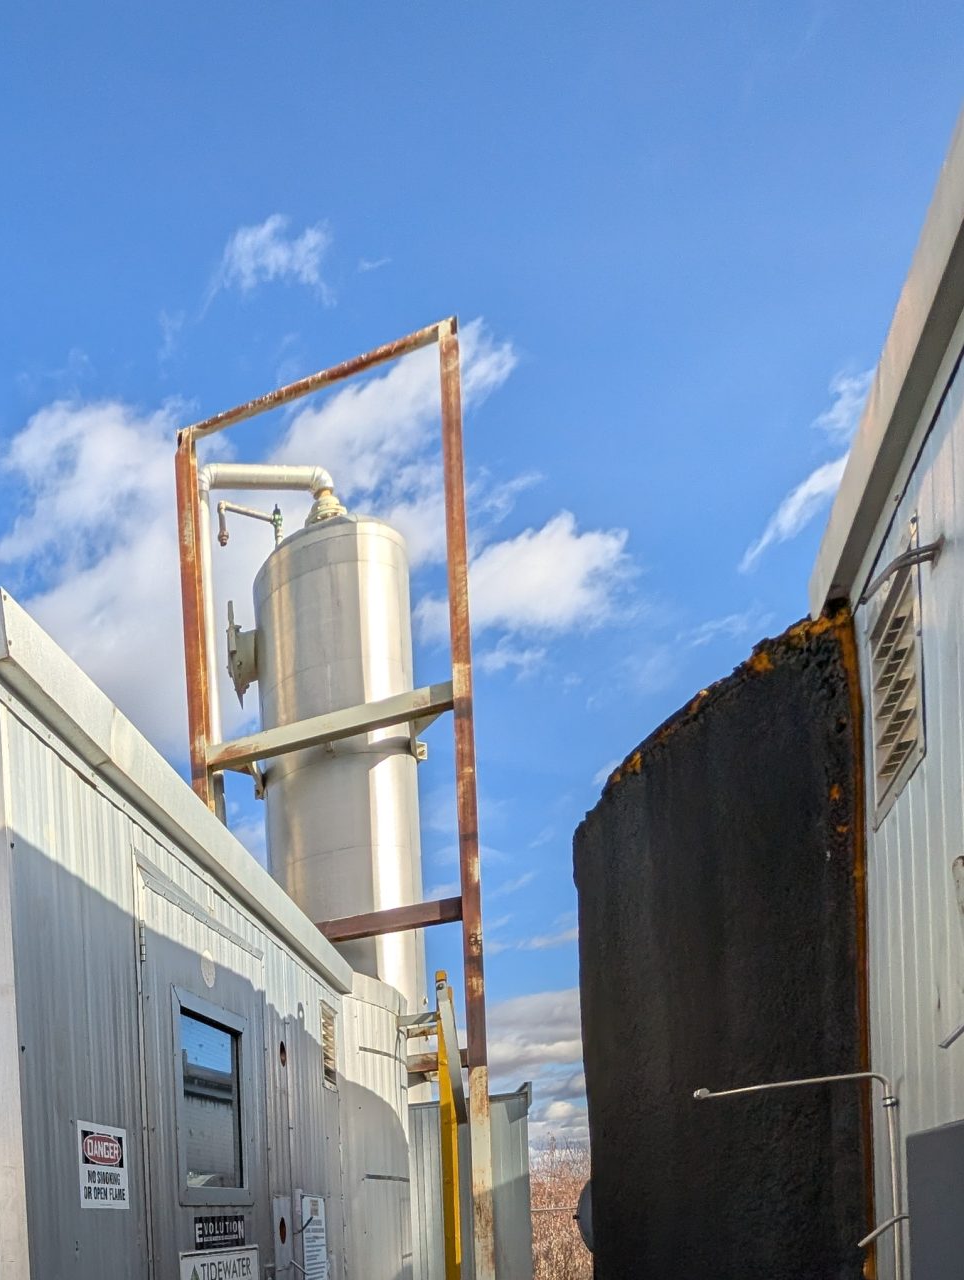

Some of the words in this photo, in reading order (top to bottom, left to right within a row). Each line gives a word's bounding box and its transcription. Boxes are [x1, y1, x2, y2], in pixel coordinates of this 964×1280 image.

[87, 1139, 118, 1159] DANGER
[87, 1170, 96, 1183] NO
[97, 1171, 120, 1185] SMOKING
[84, 1187, 92, 1200] OR
[94, 1187, 107, 1200] OPEN
[109, 1188, 125, 1200] FLAME
[196, 1221, 244, 1242] EVOLUTION
